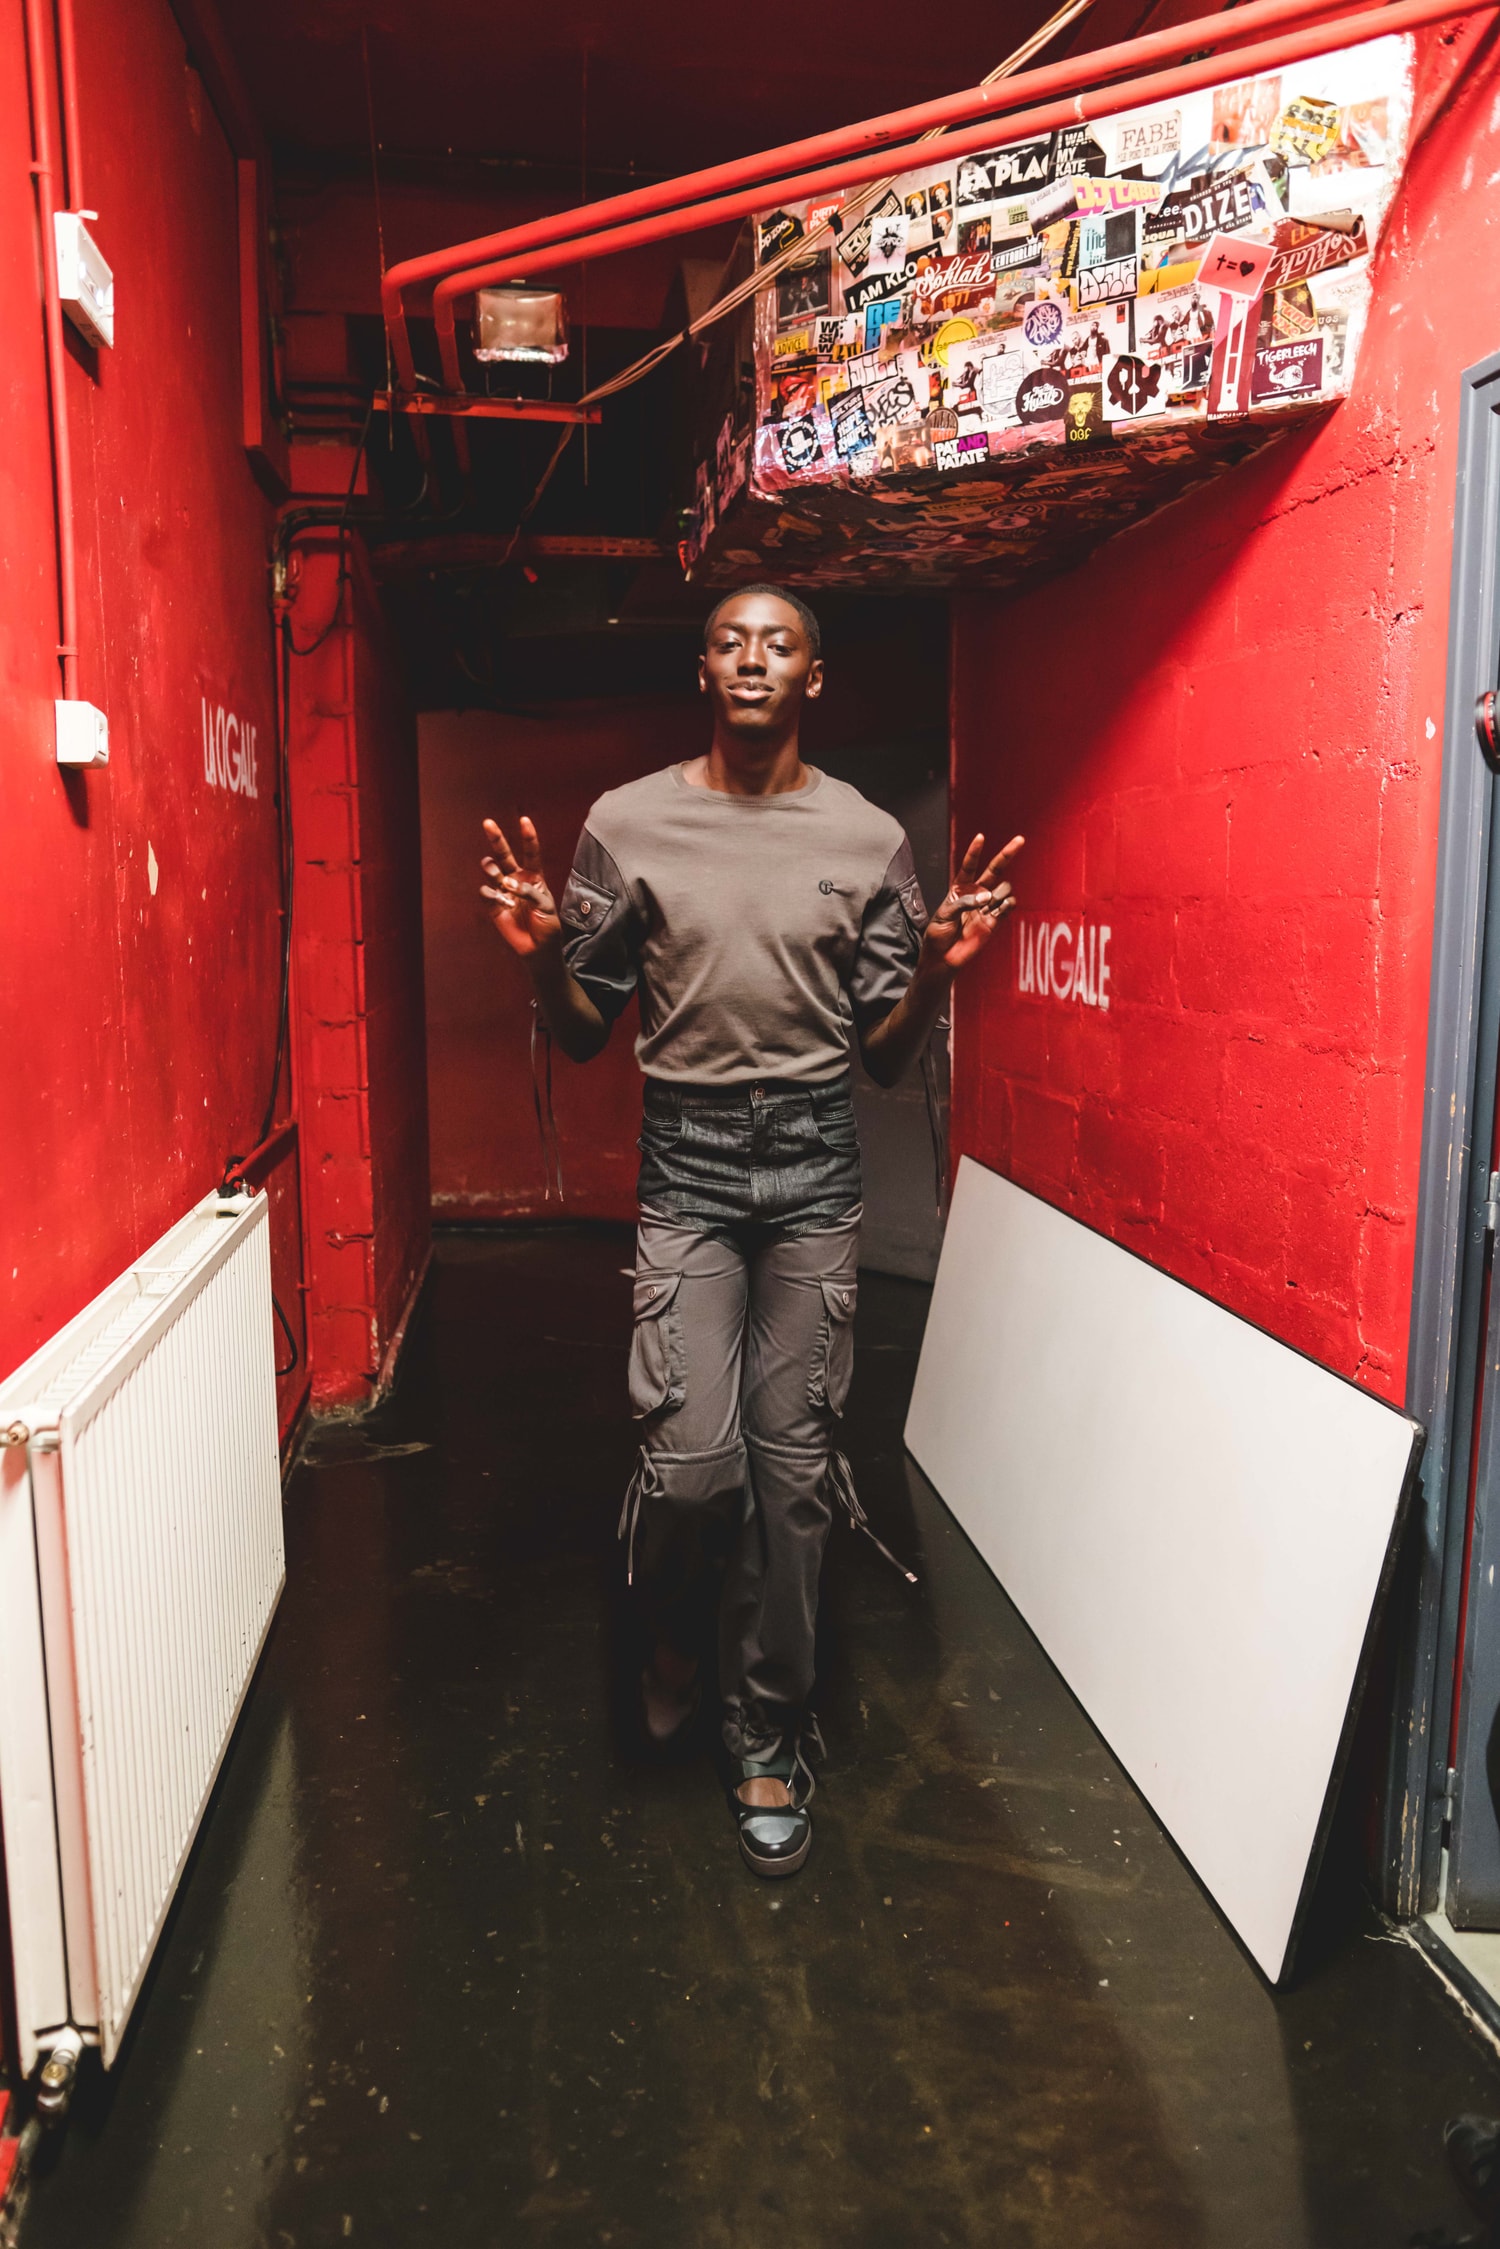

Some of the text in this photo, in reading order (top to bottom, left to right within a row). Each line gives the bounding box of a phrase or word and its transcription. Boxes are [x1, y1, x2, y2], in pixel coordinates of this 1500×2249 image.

[1122, 118, 1178, 150] FABE
[1055, 159, 1087, 178] KATE
[1181, 181, 1252, 238] DIZE
[859, 280, 884, 306] AM
[885, 248, 938, 290] KLOT
[942, 290, 971, 311] 1977
[1256, 342, 1318, 366] TIGERLEECH
